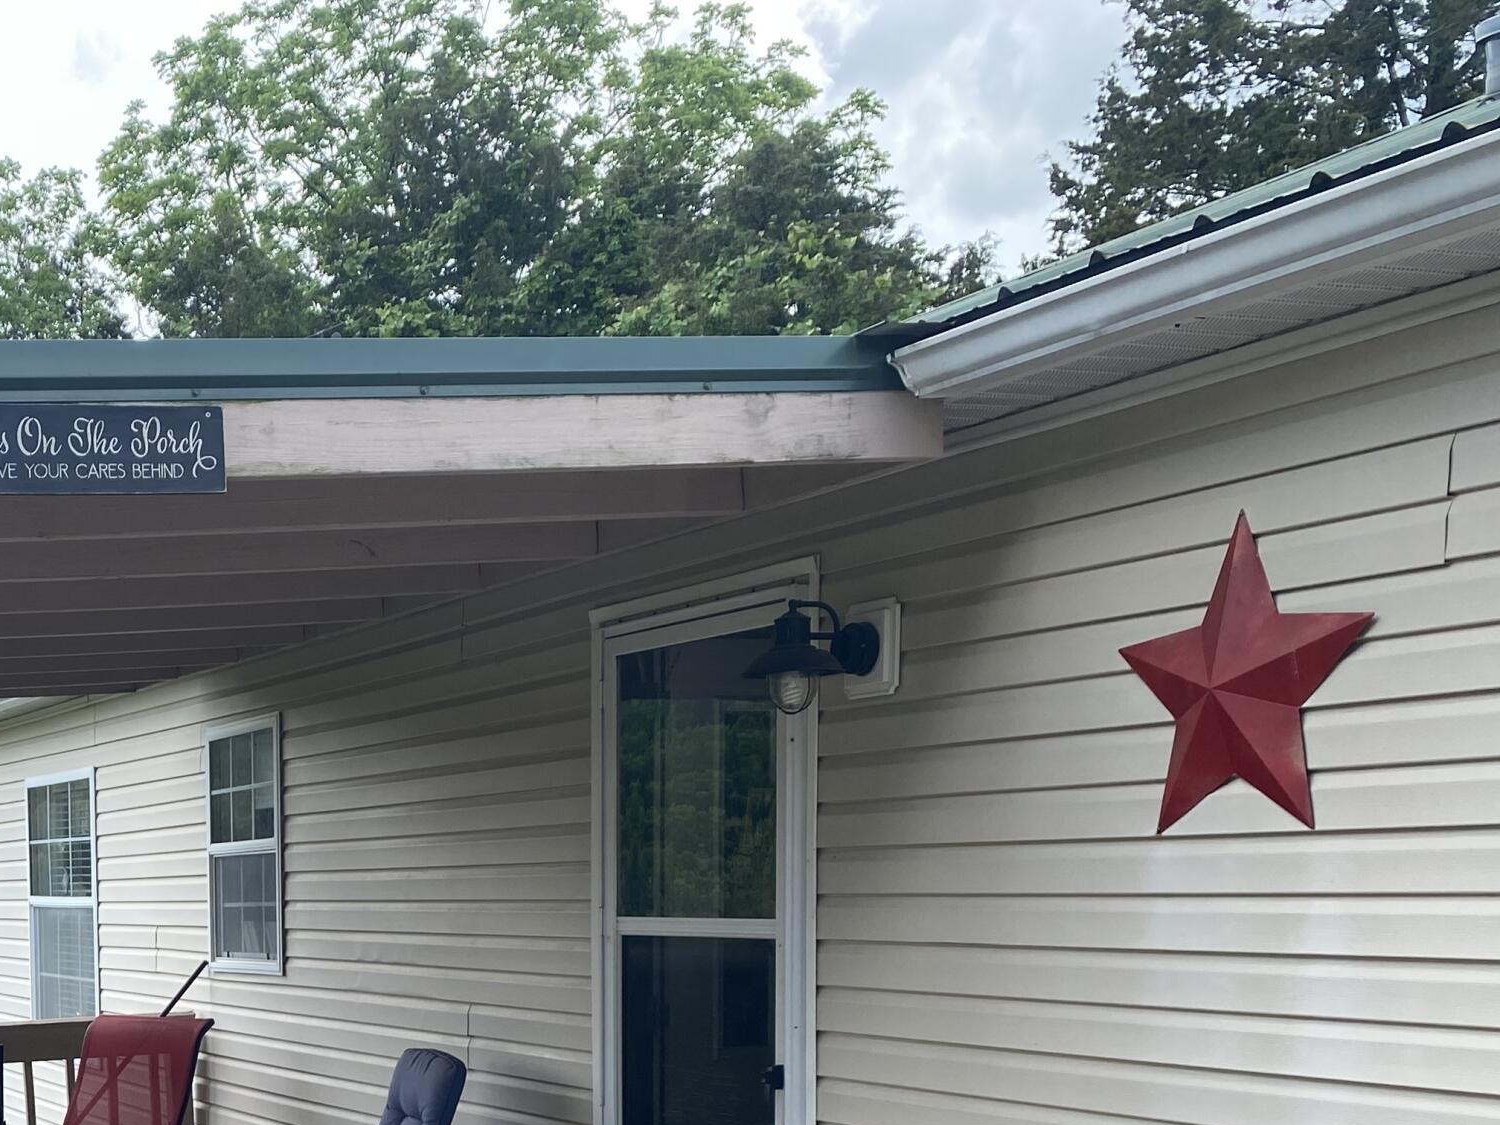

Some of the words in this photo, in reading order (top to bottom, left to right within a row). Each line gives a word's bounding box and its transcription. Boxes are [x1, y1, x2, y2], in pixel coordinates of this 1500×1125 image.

[16, 416, 62, 456] On
[67, 417, 122, 457] The
[130, 416, 217, 478] Porch
[24, 463, 69, 479] YOUR
[75, 463, 126, 479] CARES
[132, 463, 185, 479] BEHIND
